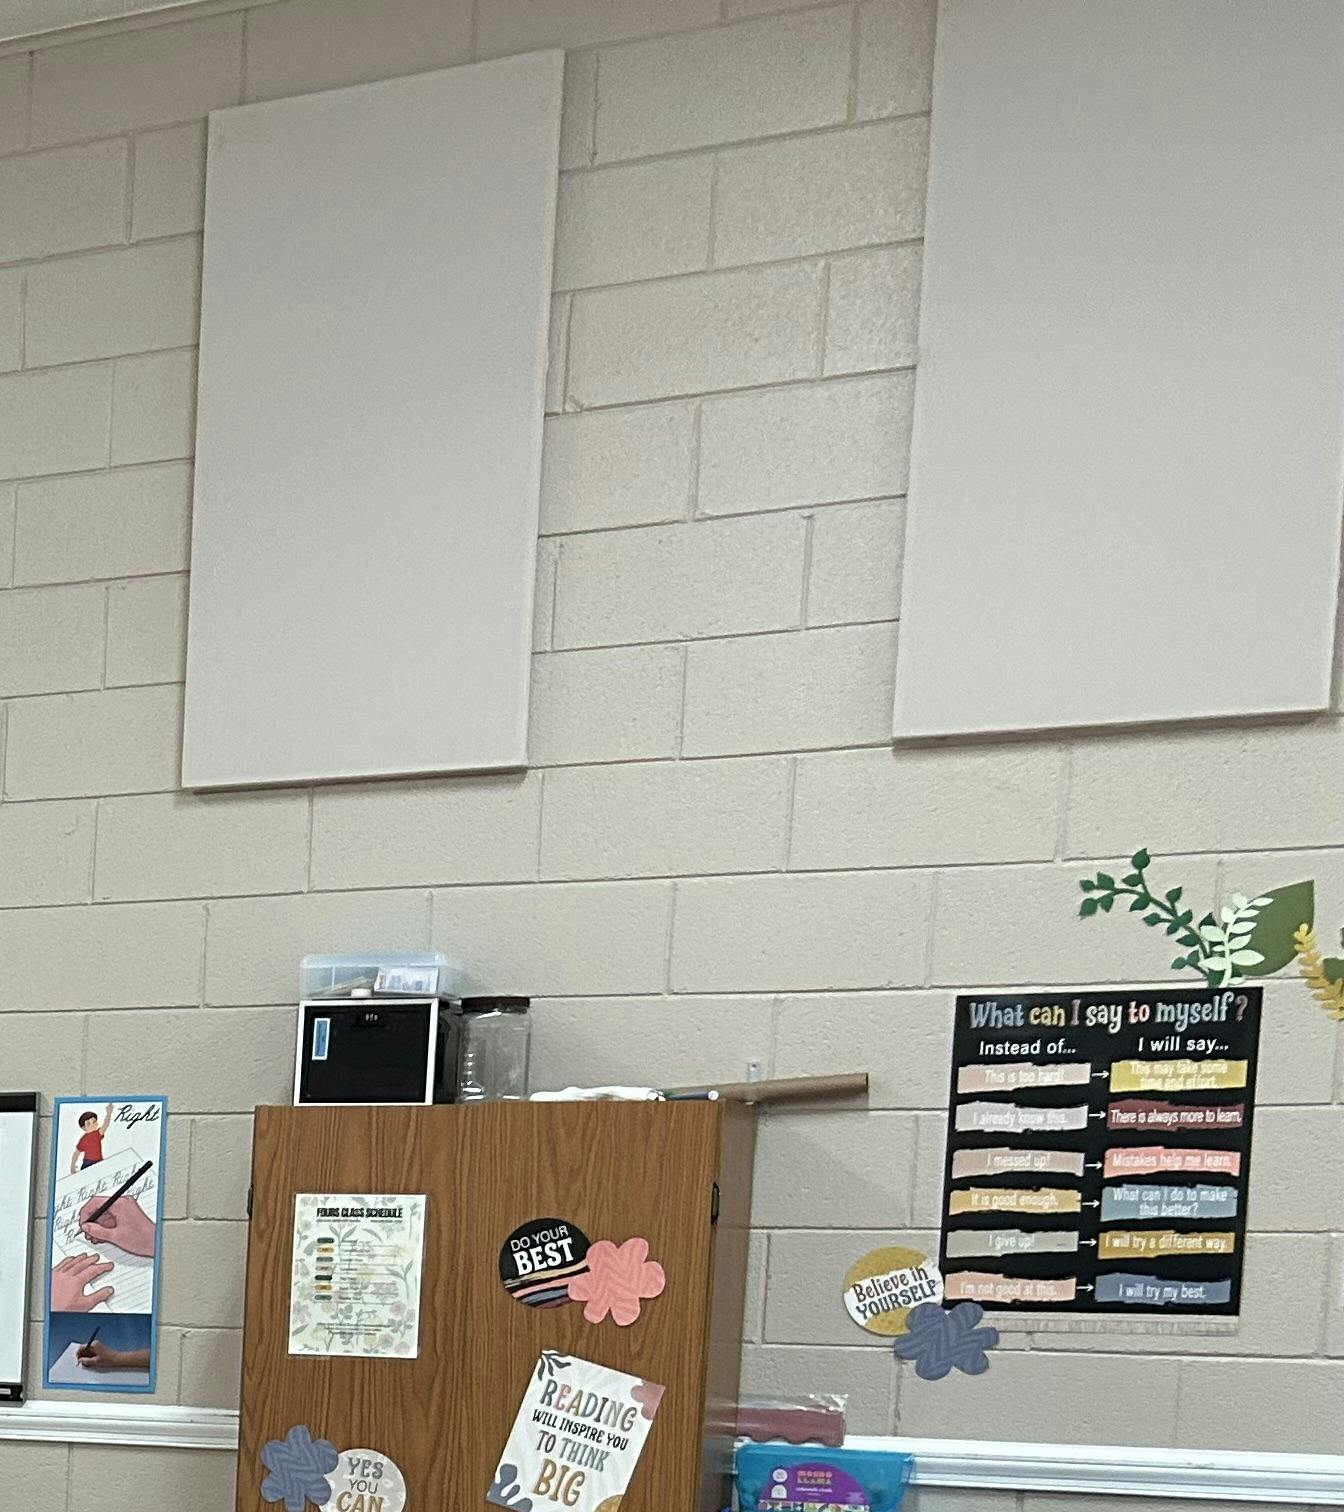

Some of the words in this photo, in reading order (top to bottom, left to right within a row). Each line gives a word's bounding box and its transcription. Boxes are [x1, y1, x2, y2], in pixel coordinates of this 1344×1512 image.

[969, 1002, 1024, 1029] What
[1029, 1005, 1066, 1026] can
[1071, 999, 1081, 1026] I
[1086, 1004, 1122, 1034] say
[1128, 1001, 1150, 1023] to
[979, 1039, 1041, 1055] Instead
[1138, 1037, 1144, 1052] I
[1151, 1036, 1180, 1052] will
[114, 1104, 160, 1129] Right
[1111, 1109, 1137, 1123] There
[1138, 1109, 1146, 1122] is
[1147, 1109, 1179, 1126] always
[1180, 1112, 1204, 1122] more
[1205, 1110, 1215, 1122] to
[316, 1207, 340, 1217] FOURS
[341, 1208, 365, 1217] CLASS
[365, 1208, 403, 1218] SCHEDULE
[510, 1237, 530, 1251] DO
[532, 1225, 568, 1244] YOUR
[513, 1237, 573, 1275] BEST
[852, 1273, 909, 1303] Believe
[912, 1266, 929, 1282] in
[1119, 1283, 1123, 1296] I
[1126, 1283, 1144, 1297] will
[1146, 1285, 1160, 1300] try
[1163, 1287, 1178, 1300] my
[856, 1279, 936, 1320] YOURSELF
[539, 1379, 637, 1432] READING
[532, 1409, 557, 1428] WILL
[559, 1418, 605, 1443] INSPIRE
[606, 1433, 629, 1451] YOU
[536, 1430, 557, 1453] TO
[559, 1438, 611, 1472] THINK
[348, 1457, 384, 1479] YES
[349, 1479, 378, 1494] YOU
[532, 1459, 585, 1506] BIG
